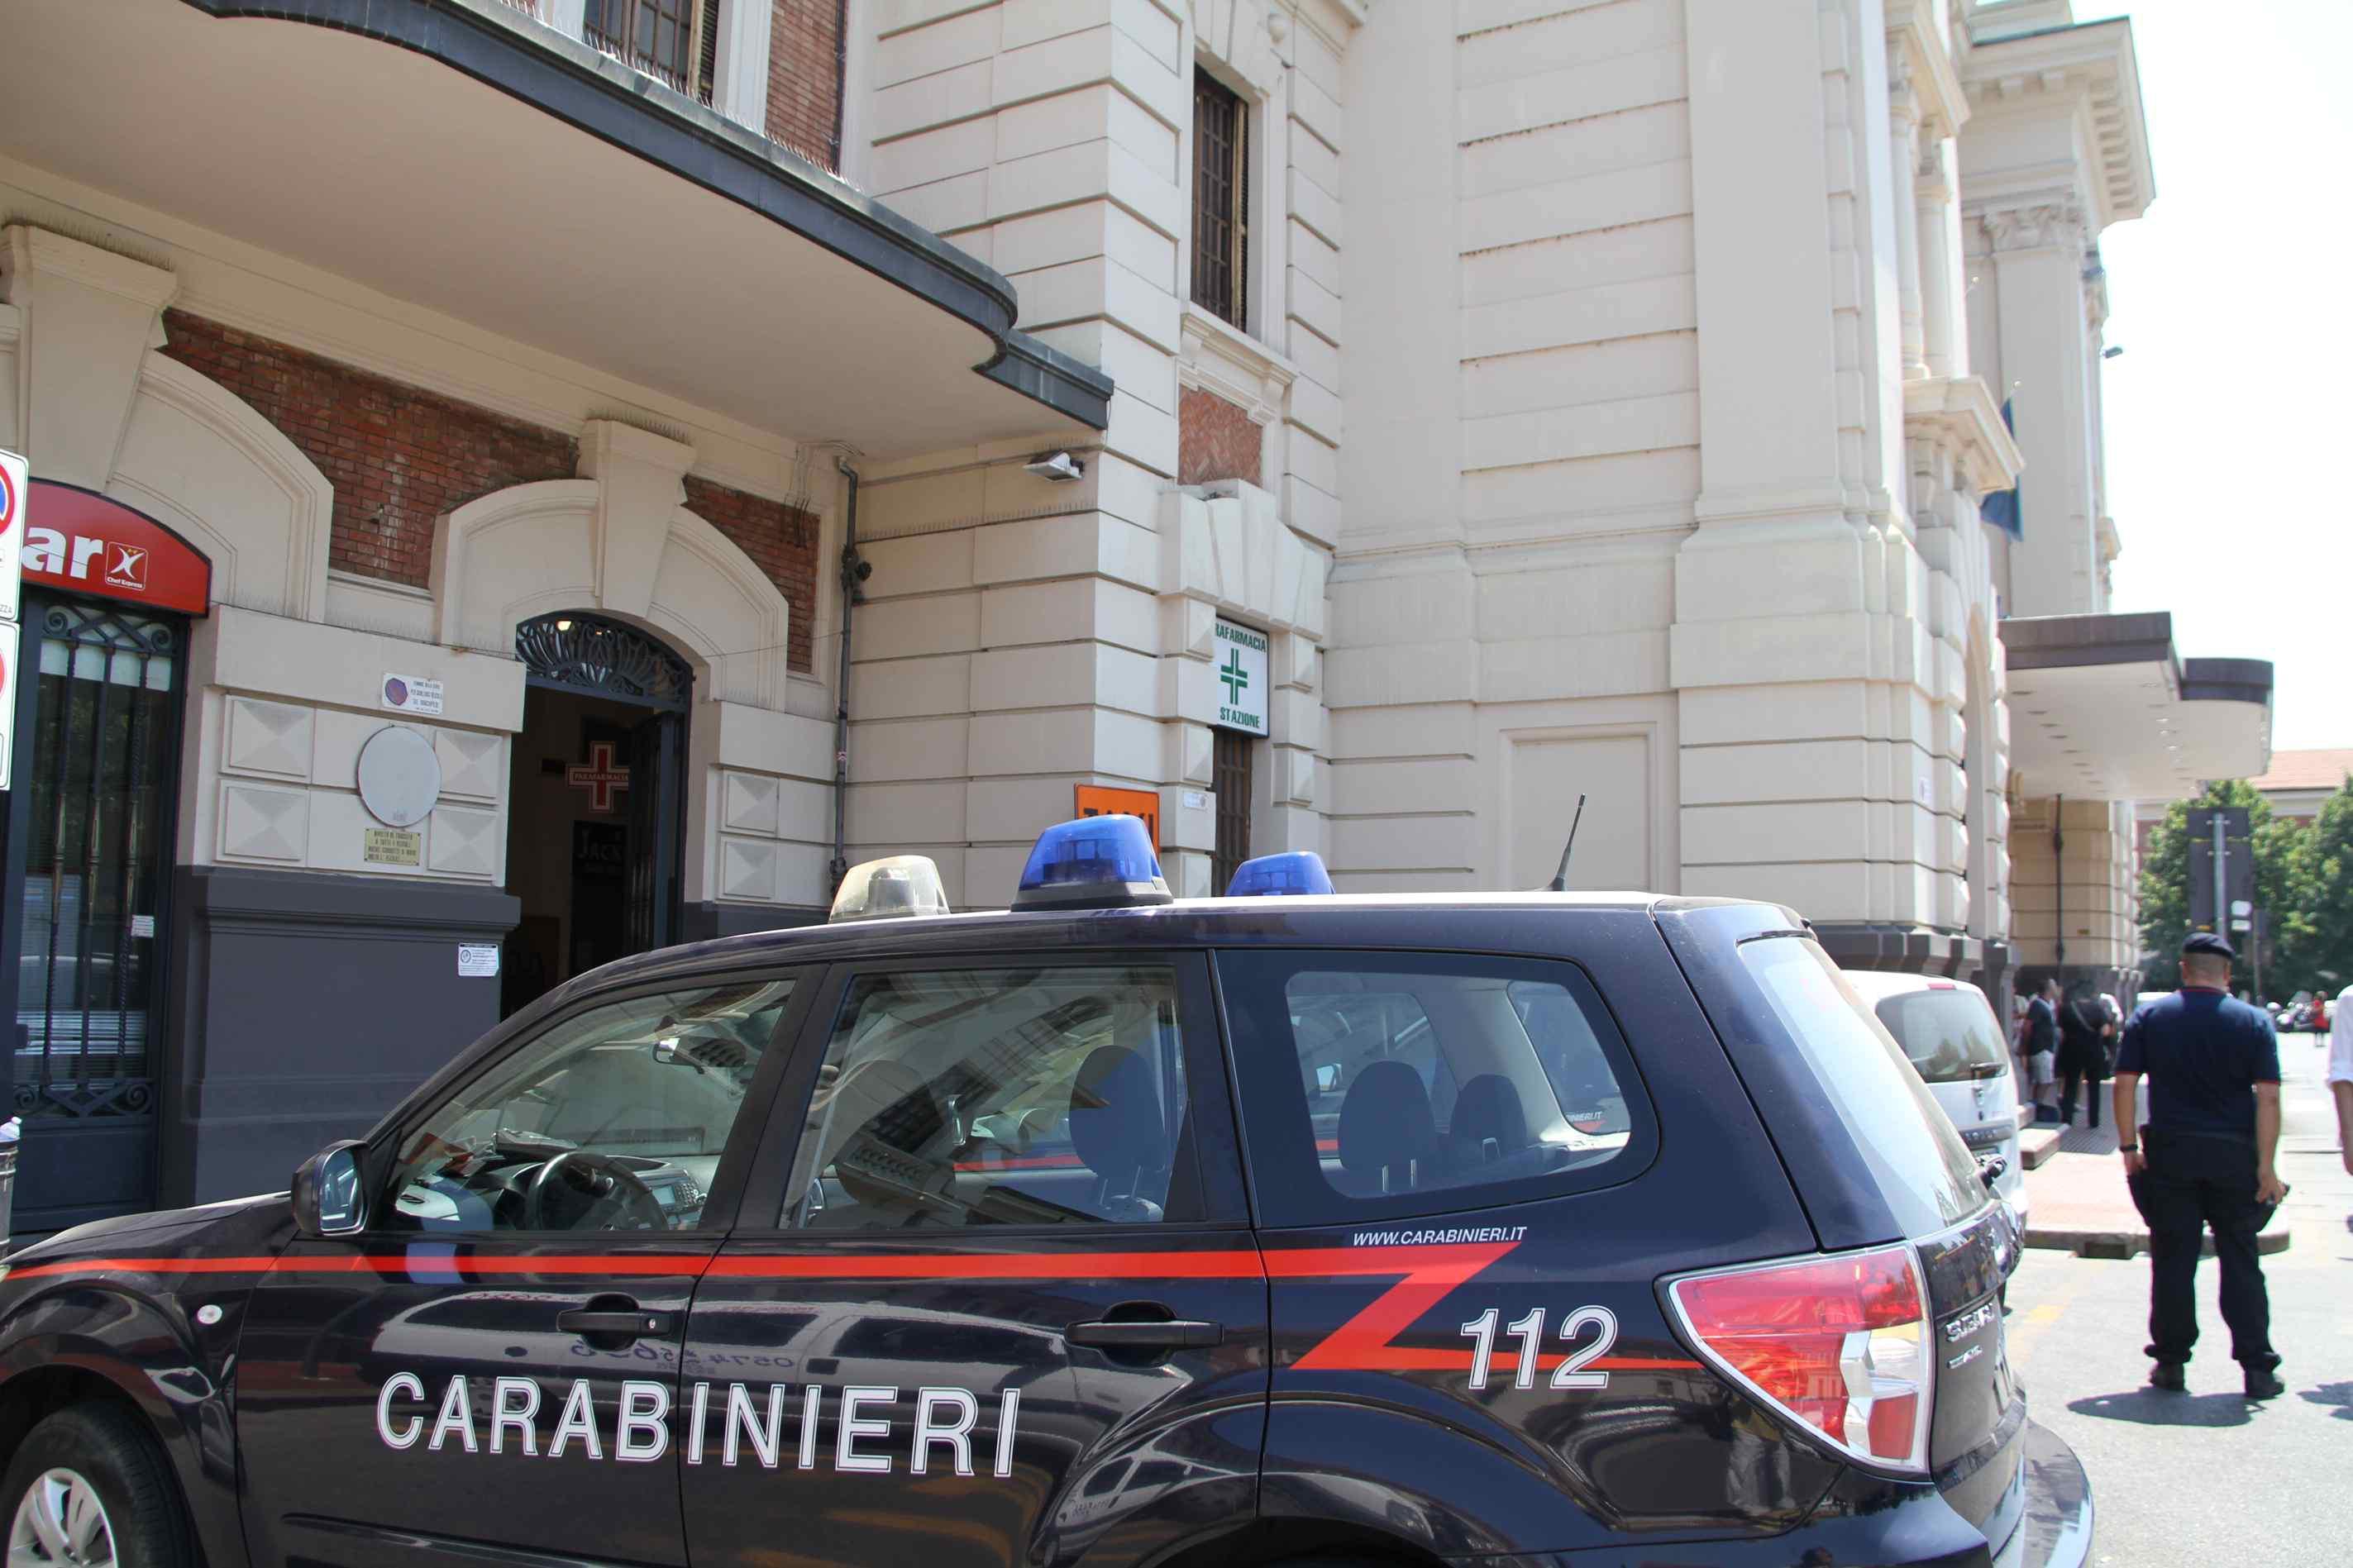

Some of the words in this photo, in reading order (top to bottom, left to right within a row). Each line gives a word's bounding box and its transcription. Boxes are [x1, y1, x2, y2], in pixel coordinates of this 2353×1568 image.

[1353, 1227, 1527, 1246] WWW.CARABINIERI.IT
[1460, 1304, 1619, 1389] 112
[375, 1370, 1022, 1479] CARABINIERI
